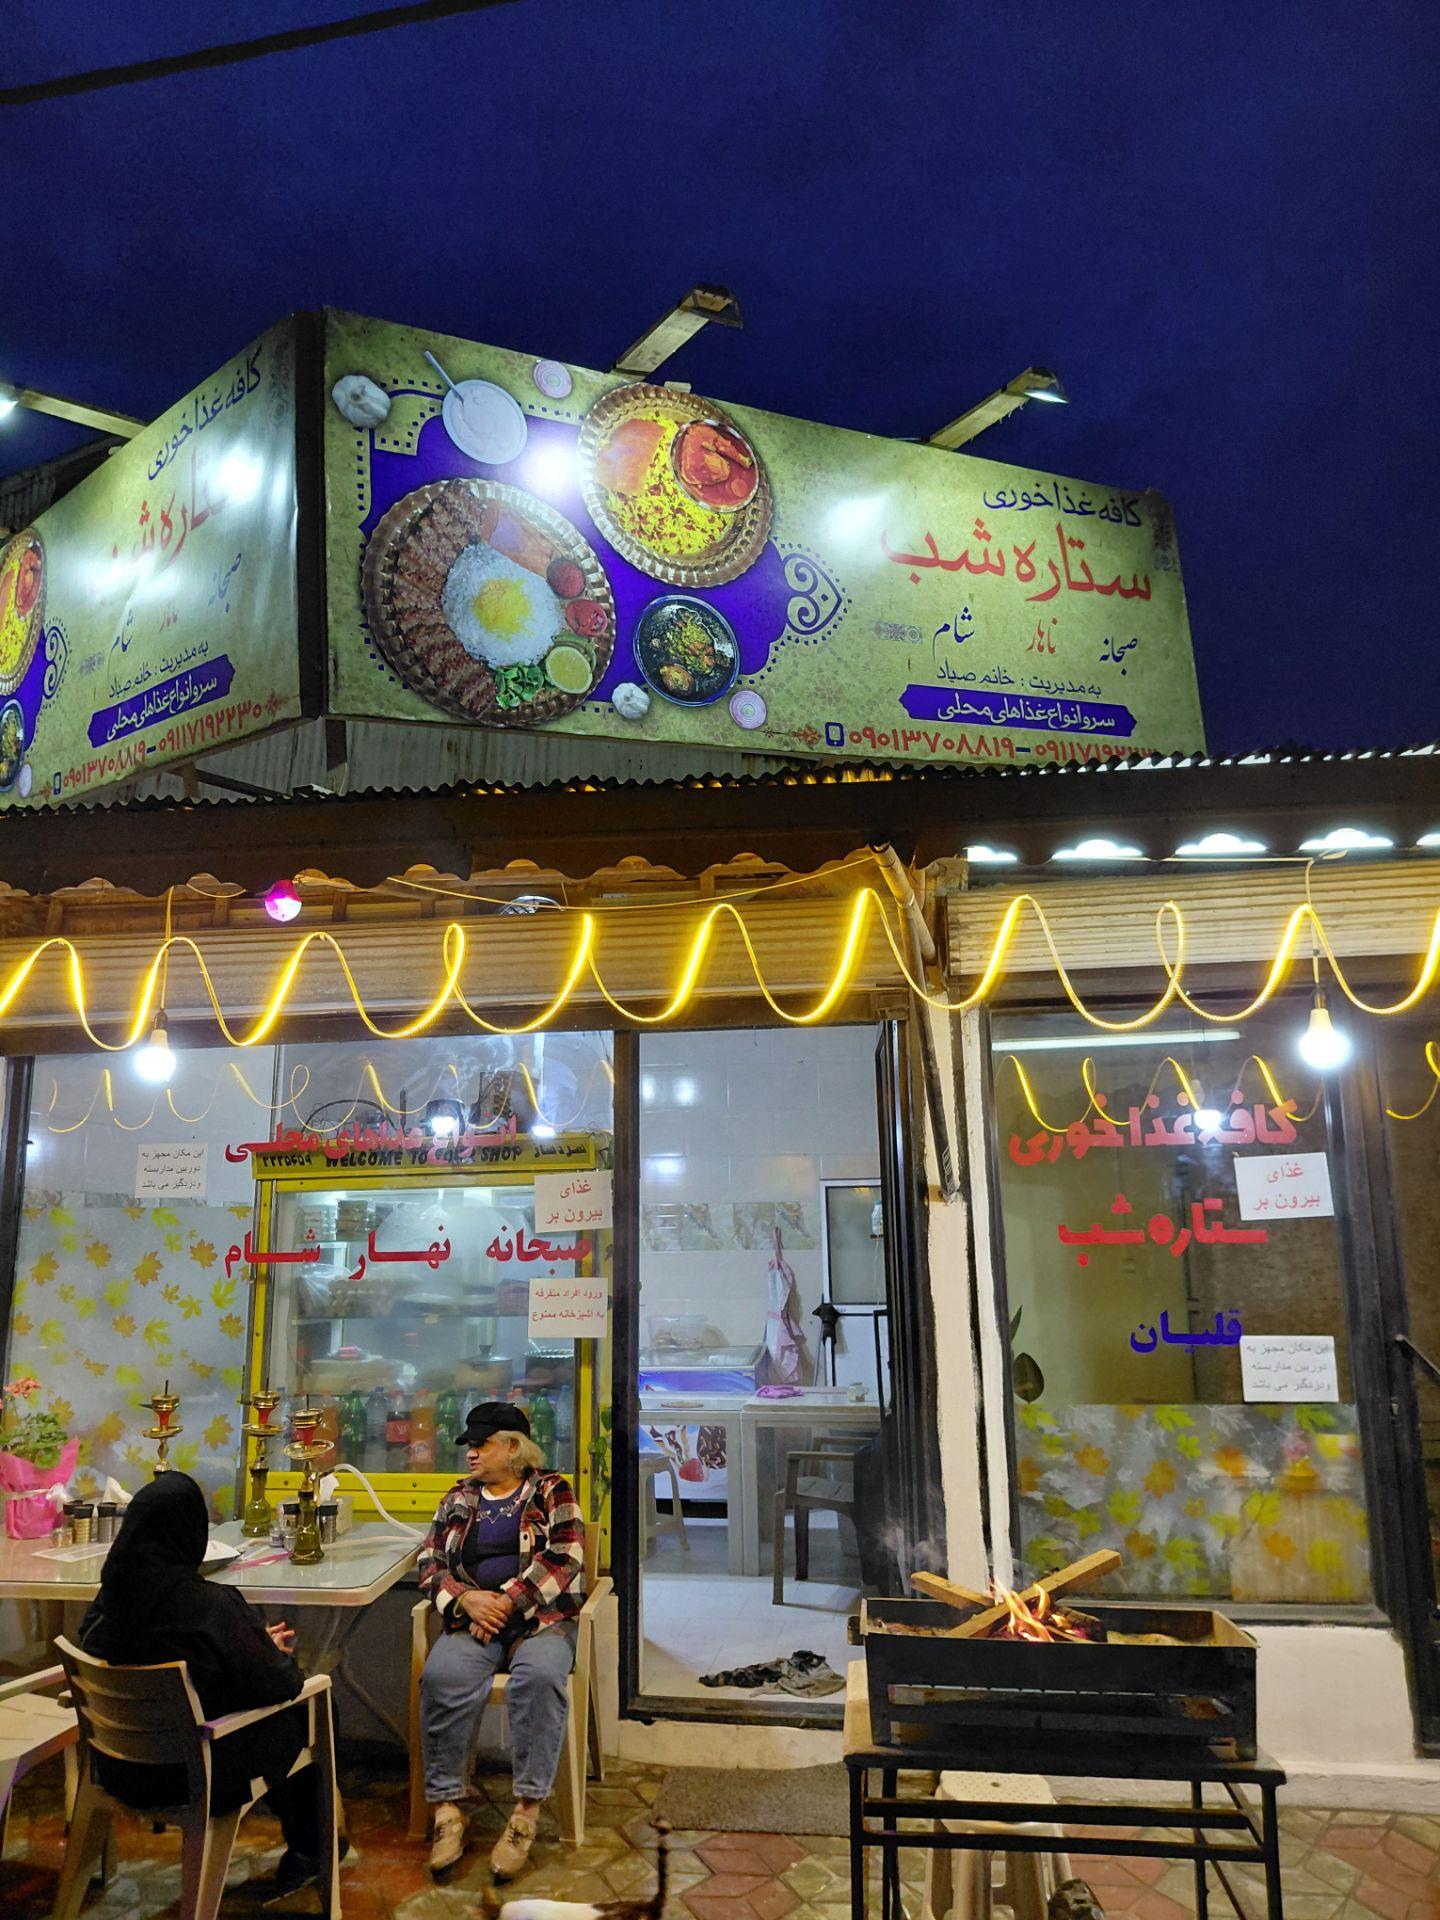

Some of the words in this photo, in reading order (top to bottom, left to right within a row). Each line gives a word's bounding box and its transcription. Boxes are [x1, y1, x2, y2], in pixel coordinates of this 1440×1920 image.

[224, 344, 263, 403] کافه
[1099, 497, 1143, 528] کافه
[881, 518, 1006, 585] شب
[1012, 521, 1152, 602] ستاره
[933, 606, 976, 664] شام
[936, 657, 977, 683] صیاد
[1099, 635, 1139, 677] صبحانه
[979, 664, 1016, 686] خانم
[937, 692, 992, 721] محلی
[990, 697, 1049, 724] غذاهای
[1047, 702, 1082, 730] انواع
[106, 707, 138, 741] محلی
[225, 1120, 320, 1163] محلی
[325, 1150, 403, 1168] WELCOME
[407, 1149, 428, 1165] TO
[480, 1145, 523, 1163] SHOP
[1267, 1161, 1304, 1184] غذای
[559, 1178, 592, 1199] غذای
[1274, 1194, 1321, 1209] بیرون
[544, 1211, 560, 1225] بر
[564, 1208, 603, 1223] بیرون
[1253, 1197, 1269, 1212] بر
[1057, 1193, 1146, 1268] شب
[224, 1227, 322, 1280] شام
[348, 1224, 452, 1281] نهار
[485, 1225, 592, 1276] صبحانه
[1129, 1308, 1242, 1353] قلیان
